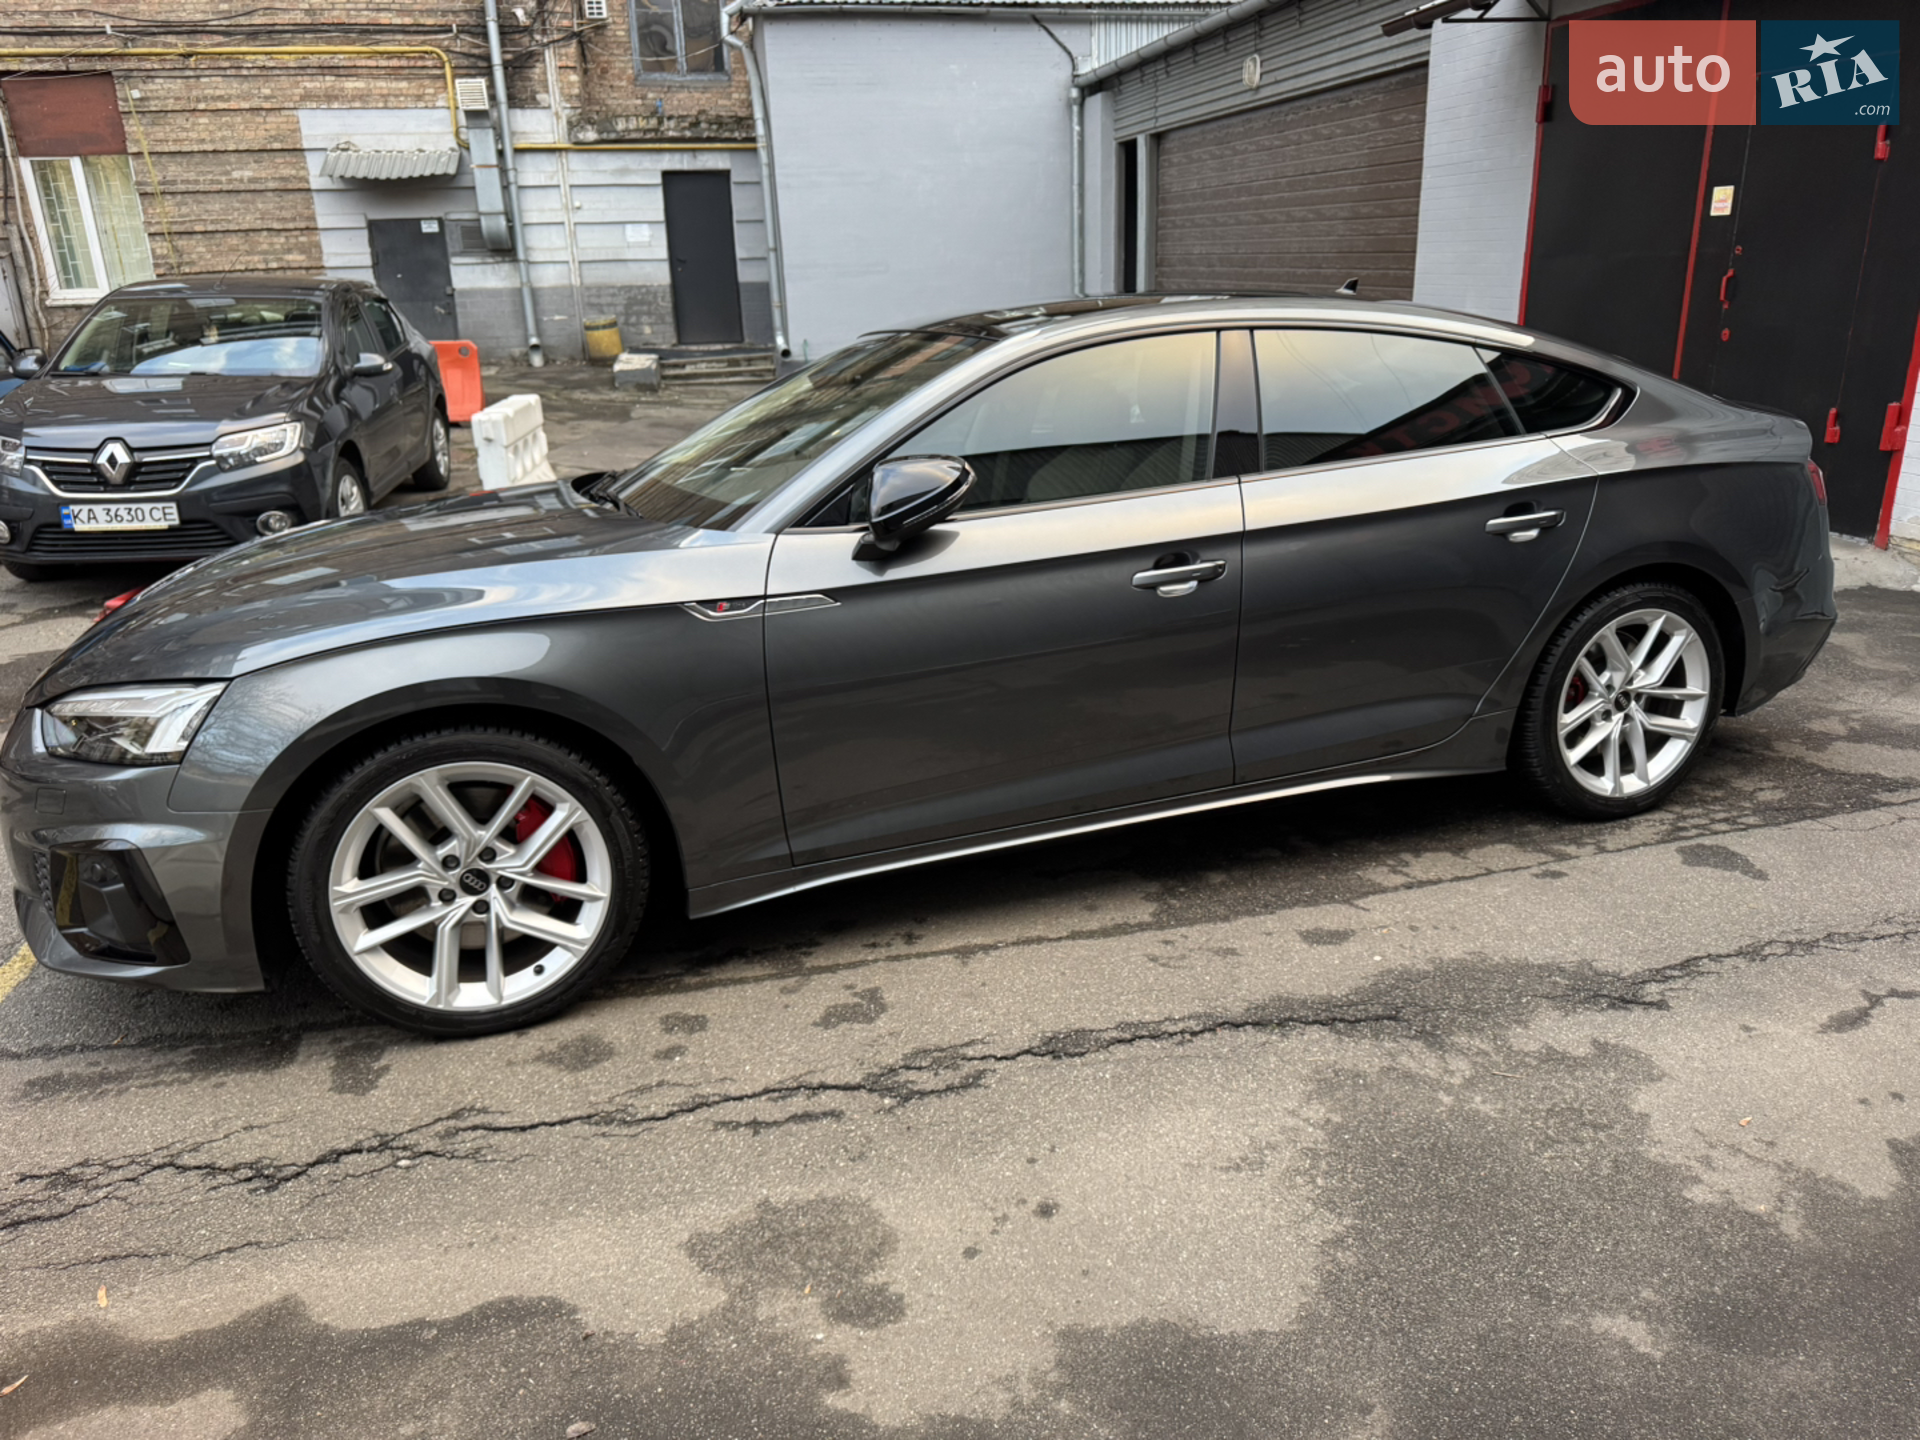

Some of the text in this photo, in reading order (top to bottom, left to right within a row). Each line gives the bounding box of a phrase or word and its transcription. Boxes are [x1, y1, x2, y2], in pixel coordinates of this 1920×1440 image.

[71, 507, 99, 524] KA
[102, 506, 146, 523] 3630
[149, 505, 177, 522] CE
